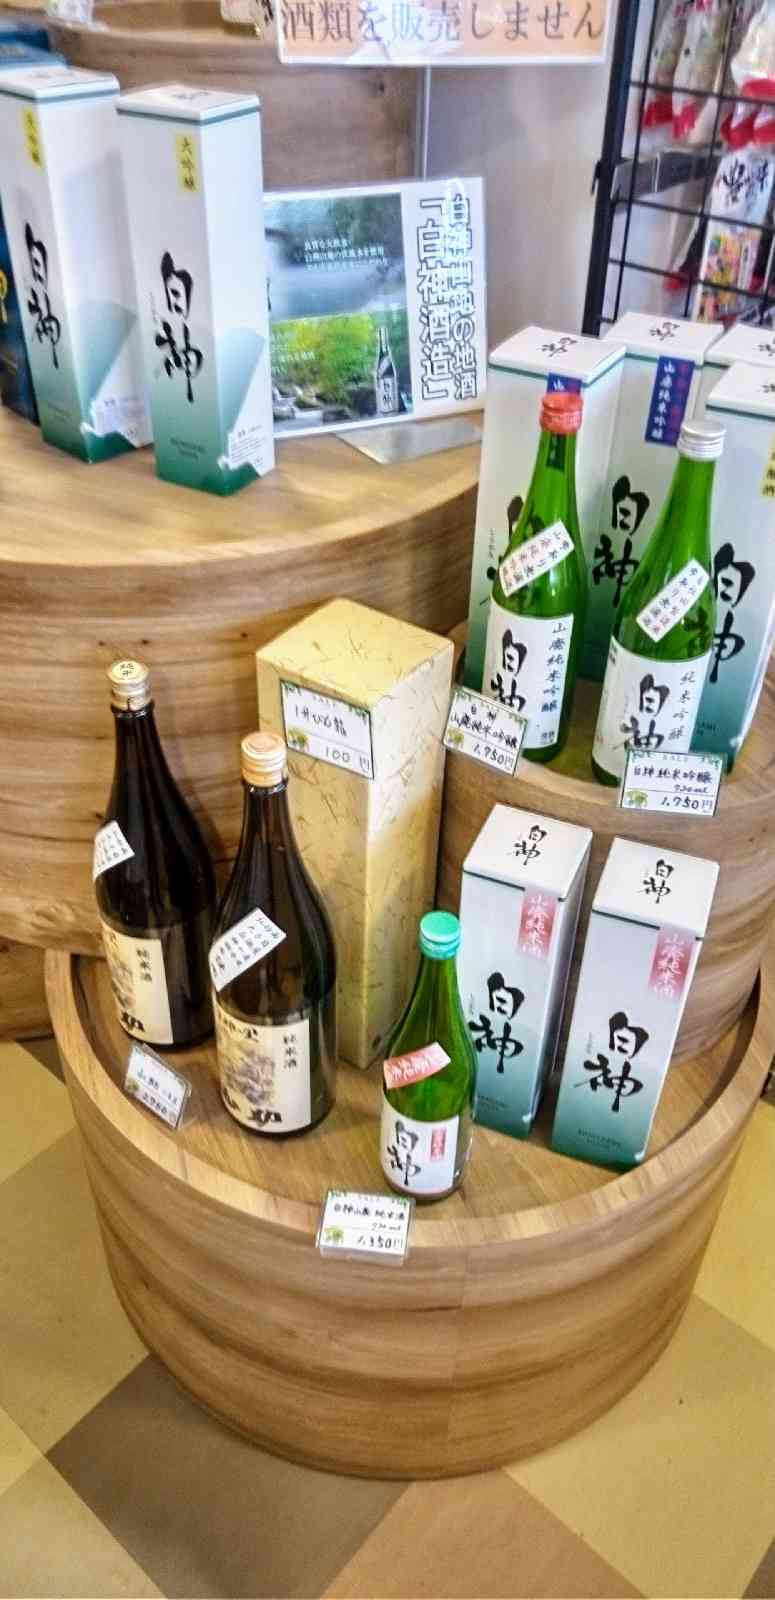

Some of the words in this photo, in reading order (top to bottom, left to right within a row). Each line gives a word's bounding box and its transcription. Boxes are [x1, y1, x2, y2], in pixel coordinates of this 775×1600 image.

[155, 251, 203, 403] 白神
[514, 825, 547, 865] 白神
[643, 859, 674, 904] 白神
[468, 972, 525, 1074] 白神
[573, 1011, 649, 1112] 白神
[386, 1120, 421, 1186] 白神
